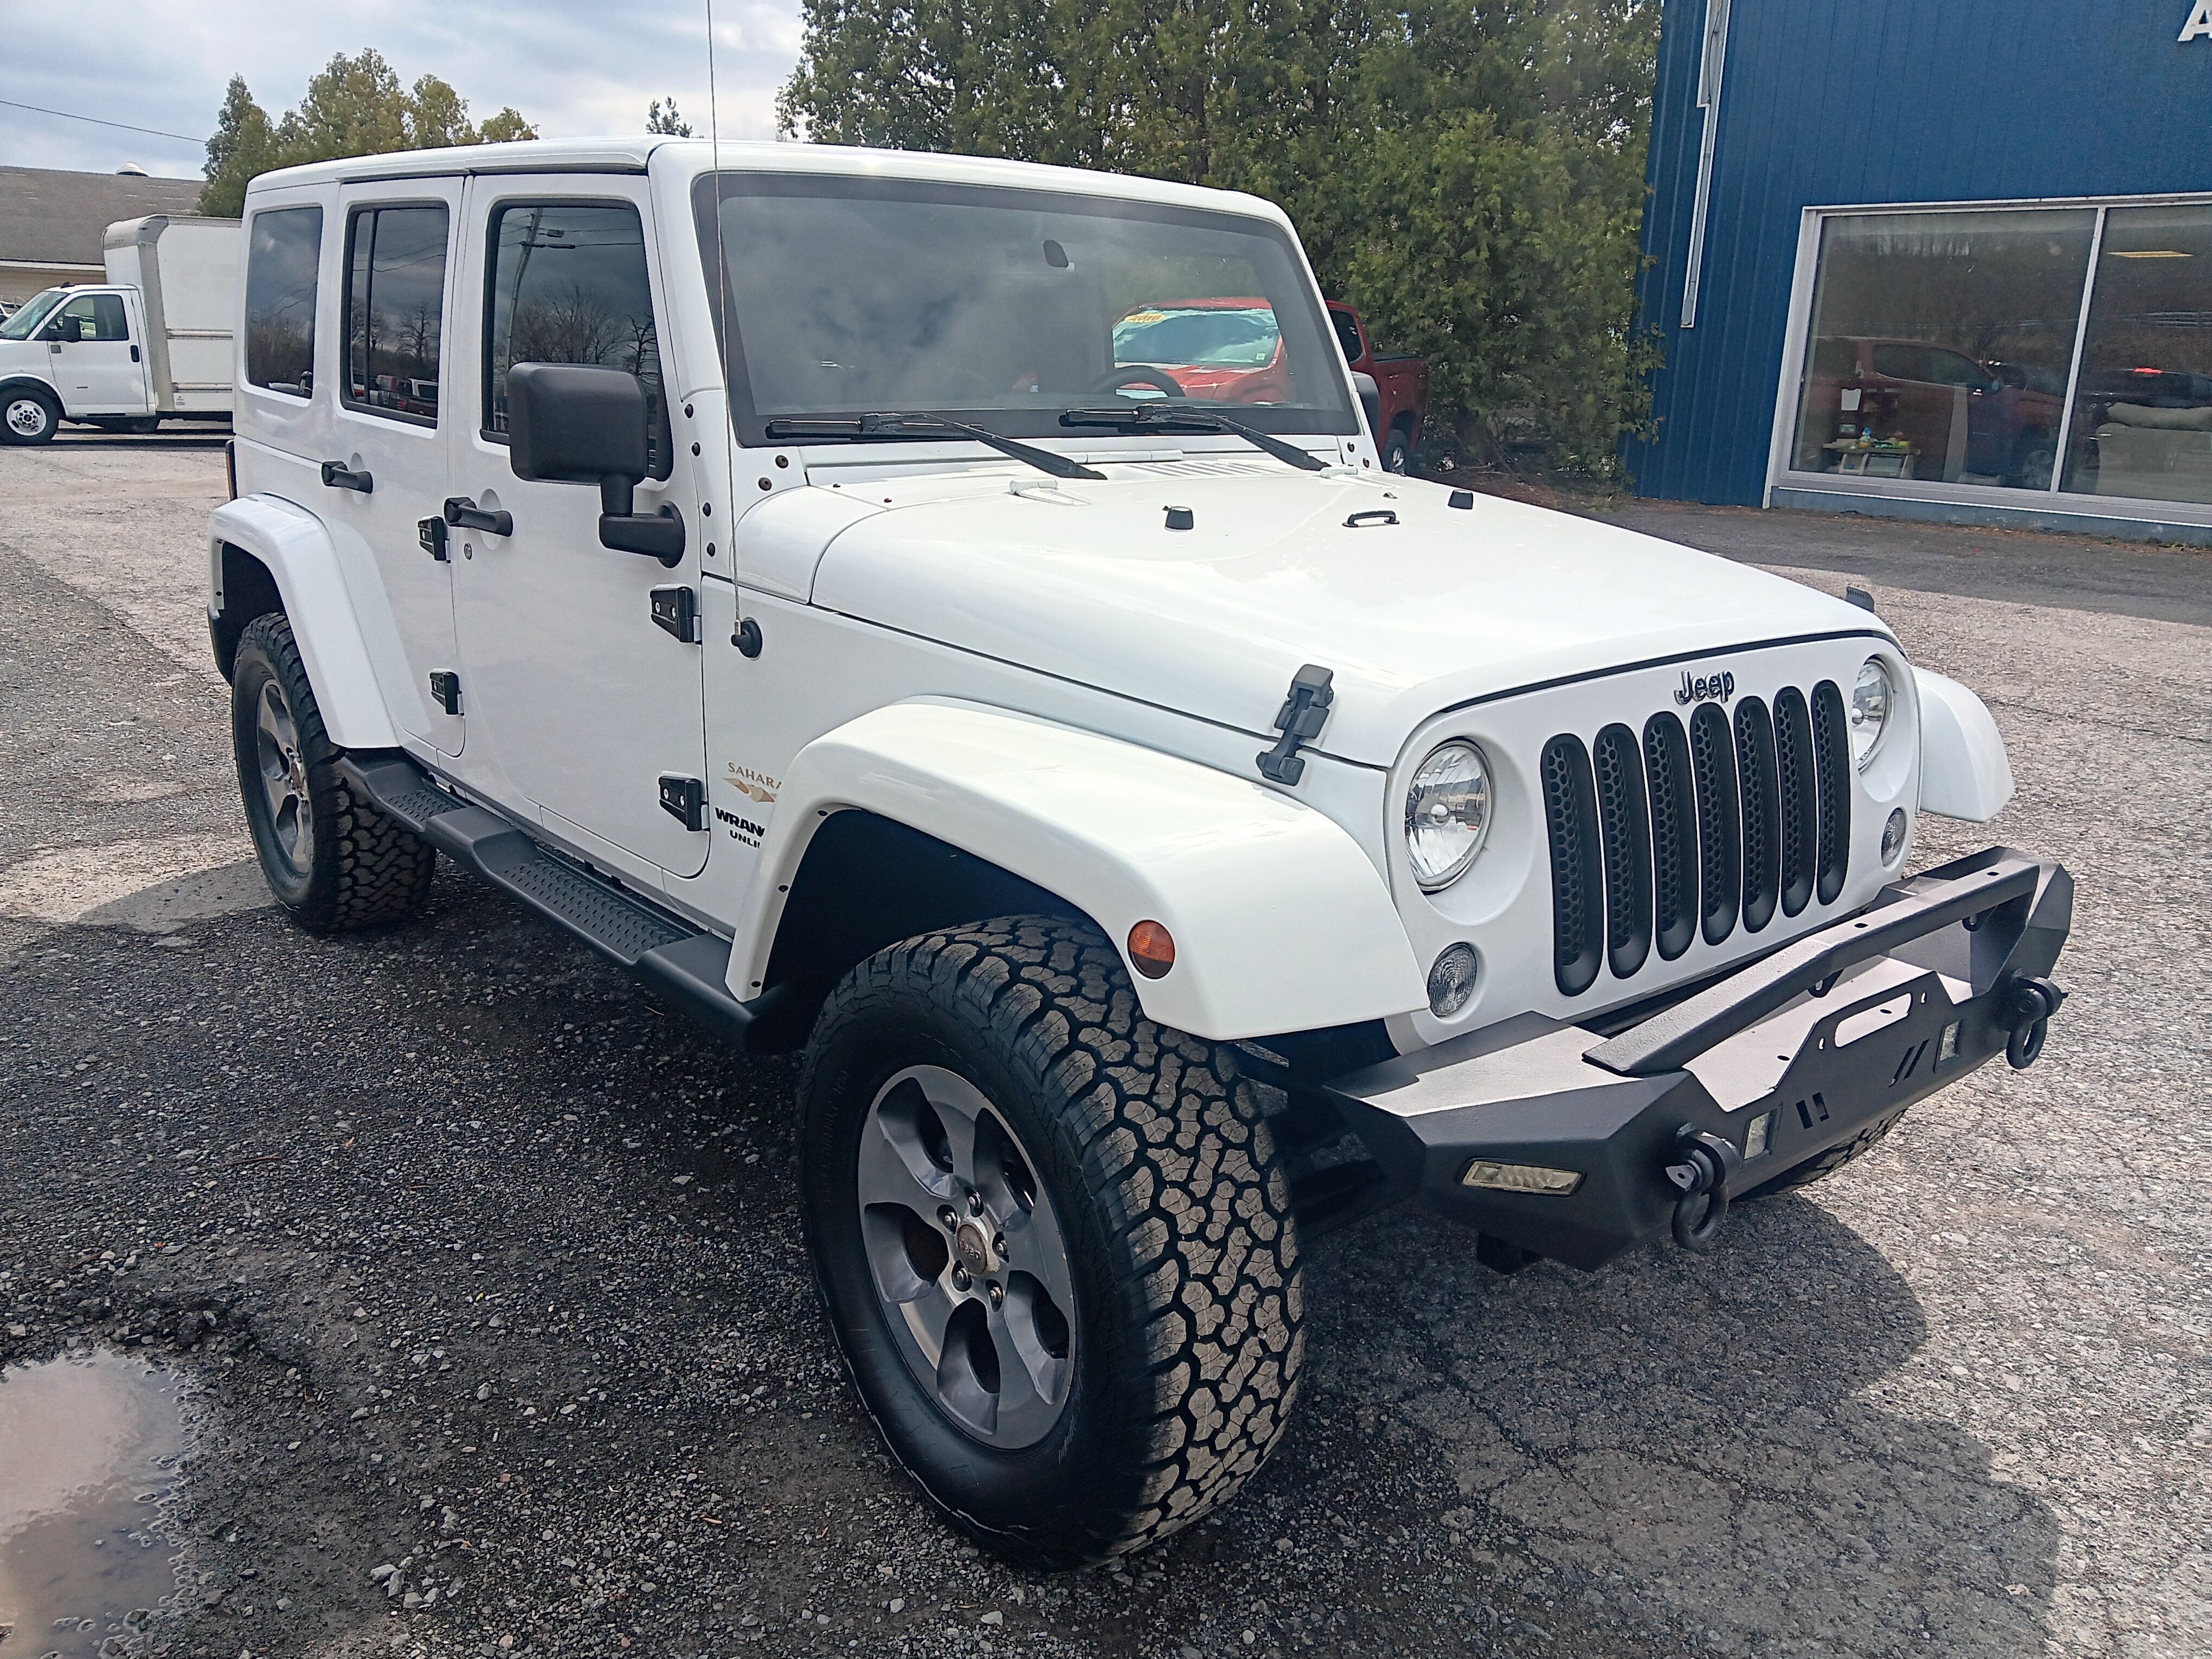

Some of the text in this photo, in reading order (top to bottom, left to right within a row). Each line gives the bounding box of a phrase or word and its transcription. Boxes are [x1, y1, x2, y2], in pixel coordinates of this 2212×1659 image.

[1674, 670, 1734, 705] Jeep
[715, 807, 765, 837] WRAN
[730, 829, 760, 848] UNLI
[959, 1239, 981, 1260] Jeep
